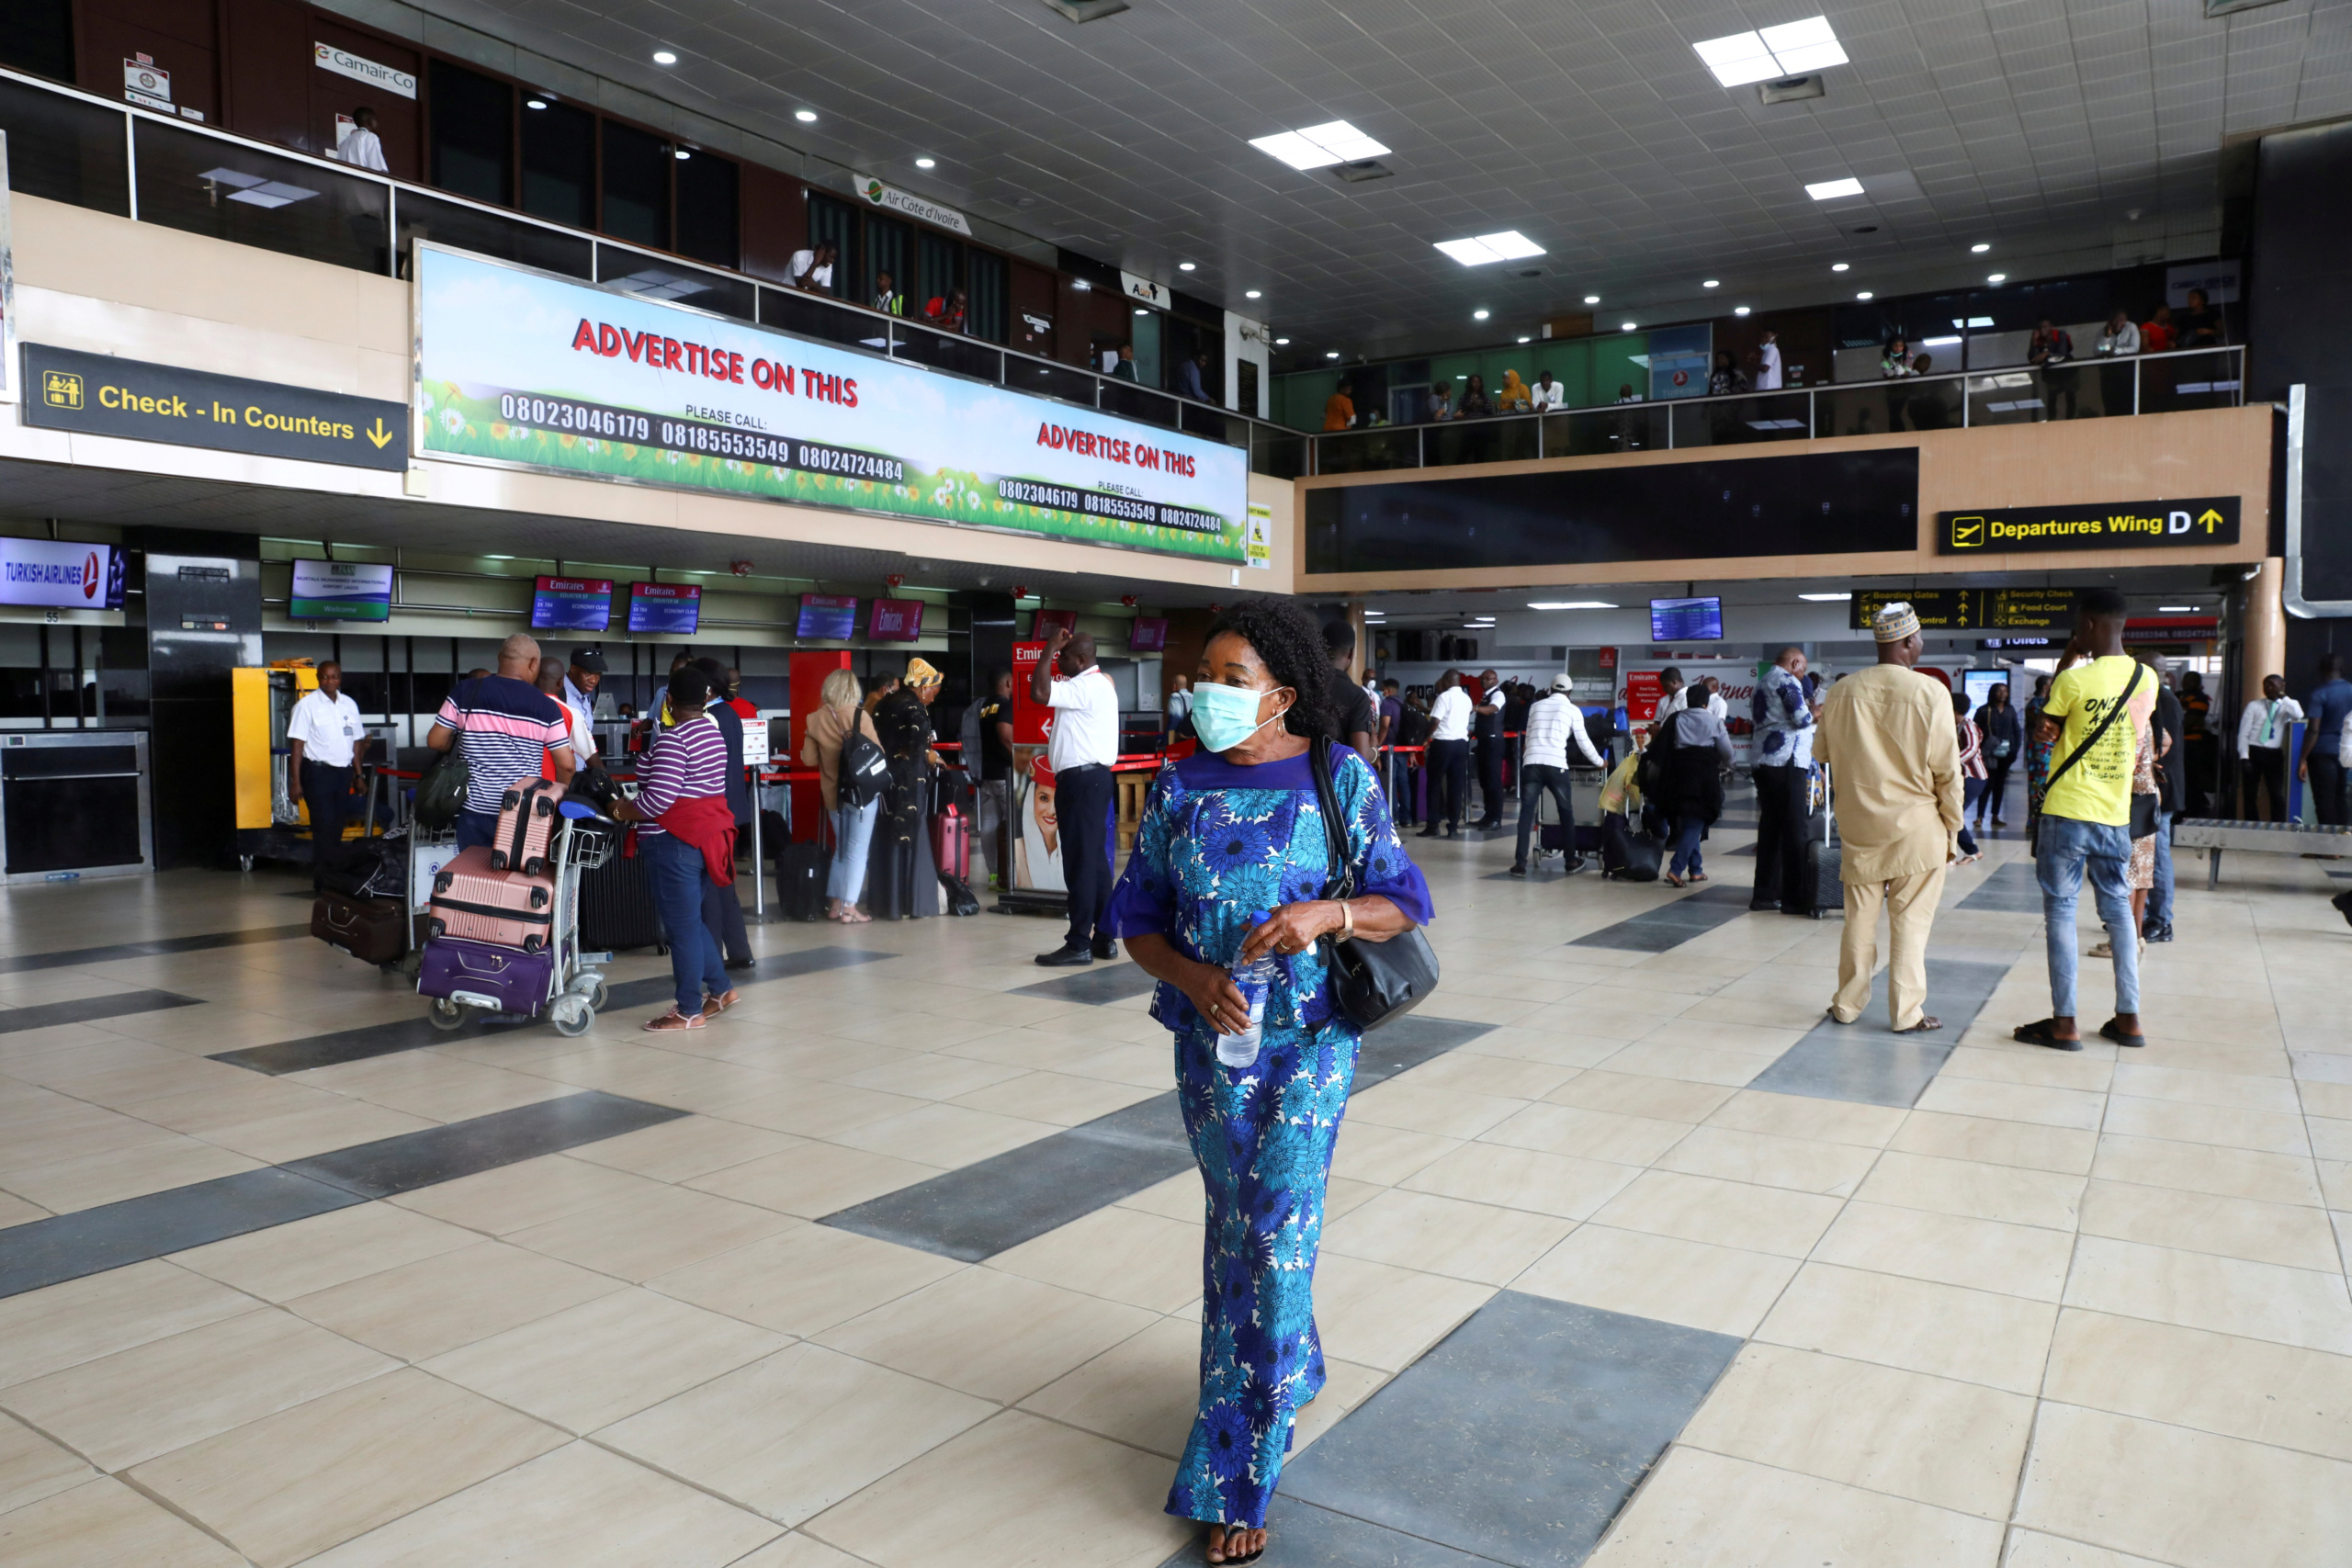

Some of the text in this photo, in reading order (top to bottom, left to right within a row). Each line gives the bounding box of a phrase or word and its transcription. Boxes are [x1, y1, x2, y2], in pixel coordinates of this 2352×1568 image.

[334, 51, 413, 89] Camair-Co
[884, 191, 960, 229] Air Côte d'Ivoire
[571, 317, 858, 409] ADVERTISE ON THIS
[98, 385, 188, 418] Check
[213, 401, 236, 423] In
[244, 406, 355, 439] Counters
[685, 404, 768, 430] PLEASE CALL:
[501, 393, 903, 480] 08023046179 08185553549 08024724484
[1036, 423, 1196, 478] ADVERTISE ON THIS
[1098, 480, 1144, 498] PLEASE CALL:
[999, 479, 1221, 532] 08023046179 08185553549 08024724484
[1991, 511, 2191, 540] Departures Wing D
[6, 562, 82, 585] TURKISH AIRLINES
[549, 580, 585, 591] Emirates
[644, 586, 676, 596] Emirates
[1873, 592, 1912, 600] Boarding
[2009, 590, 2074, 599] Security Check
[46, 612, 59, 623] 55
[878, 608, 904, 631] Emirates
[2007, 617, 2050, 626] Exchange
